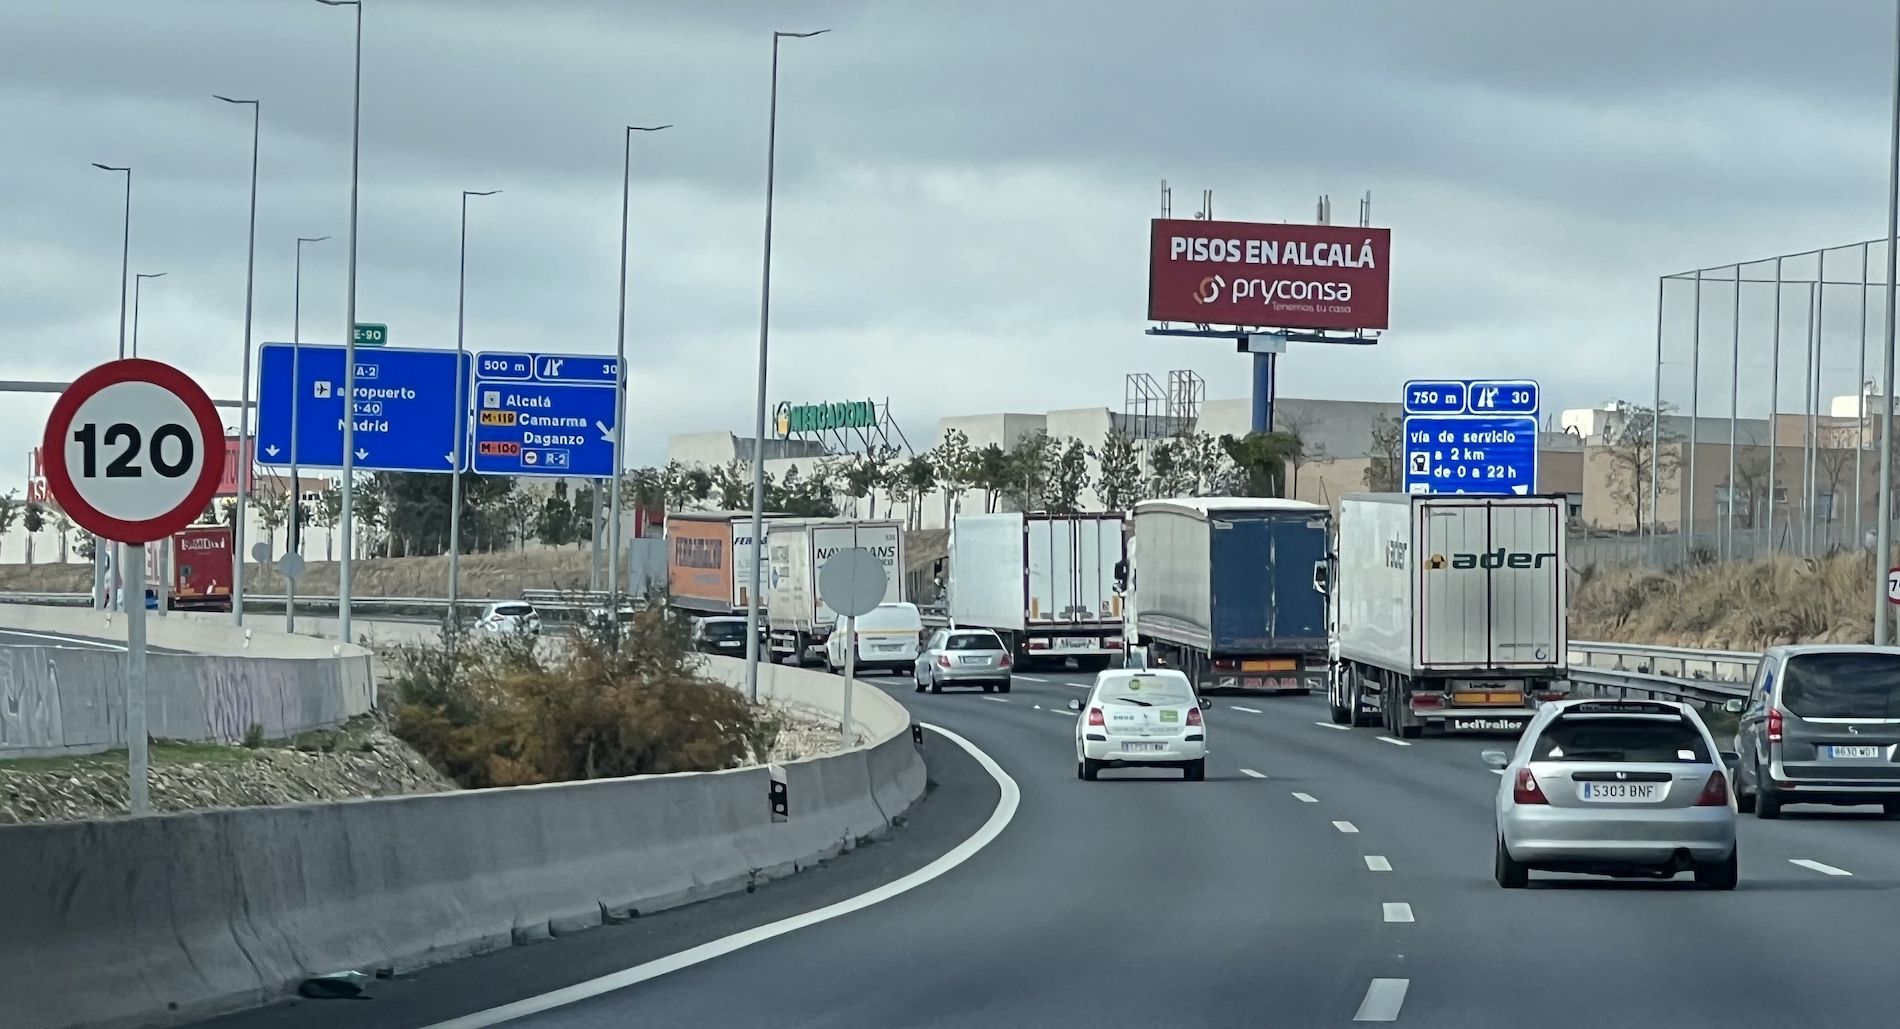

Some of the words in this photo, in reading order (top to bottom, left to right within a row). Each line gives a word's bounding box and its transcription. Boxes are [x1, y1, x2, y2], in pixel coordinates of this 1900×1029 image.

[1170, 236, 1241, 262] PISOS
[1246, 239, 1279, 265] EN
[1282, 239, 1375, 268] ALCALÁ
[1232, 278, 1352, 304] pryconsa
[1272, 301, 1314, 312] Tenemos
[1316, 304, 1327, 312] tu
[1328, 305, 1351, 313] casa
[356, 366, 376, 376] A-2
[484, 360, 508, 371] 500
[514, 363, 525, 371] m
[602, 364, 617, 374] 30
[336, 387, 416, 400] aropuerto
[1413, 391, 1439, 404] 750
[1445, 394, 1457, 404] m
[1511, 391, 1530, 404] 30
[506, 395, 551, 408] Alcalá
[519, 413, 587, 427] Camarma
[791, 401, 876, 432] MERCADONA
[523, 432, 585, 446] Daganzo
[1411, 430, 1430, 443] vía
[1438, 430, 1455, 443] de
[1463, 430, 1516, 443] servicio
[74, 423, 194, 478] 120
[1434, 450, 1443, 460] a
[1450, 447, 1460, 460] 2
[1464, 447, 1485, 460] km
[1434, 464, 1451, 478] de
[1457, 465, 1467, 478] 0
[1471, 467, 1480, 478] a
[1487, 465, 1505, 478] 22
[1507, 465, 1517, 478] h
[1452, 547, 1557, 570] ader
[1889, 579, 1900, 592] 7
[1455, 719, 1523, 729] LeciTrailer
[1593, 785, 1626, 797] 5303
[1629, 785, 1654, 798] BNF
